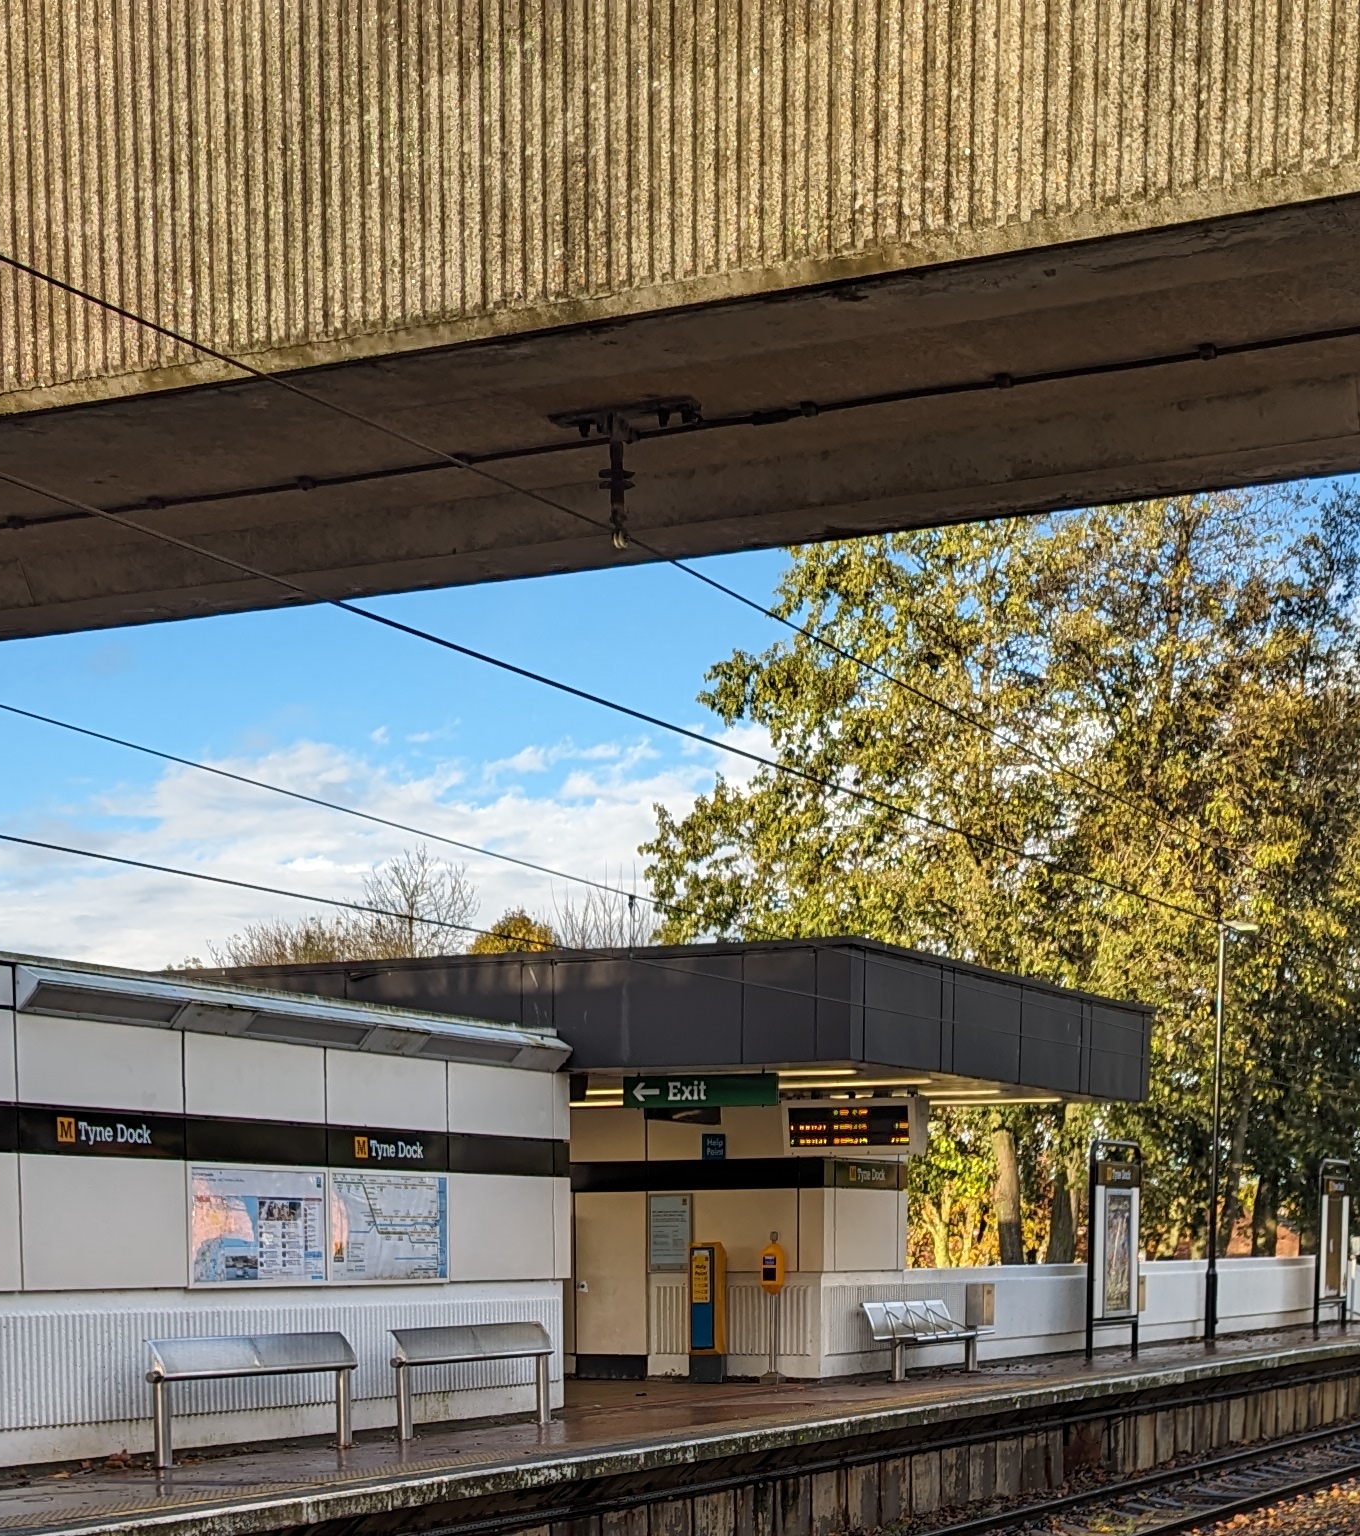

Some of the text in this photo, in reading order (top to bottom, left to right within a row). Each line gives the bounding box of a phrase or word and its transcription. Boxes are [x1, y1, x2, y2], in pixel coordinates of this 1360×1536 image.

[667, 1081, 707, 1101] Exit
[59, 1119, 152, 1144] M Tyne Dock
[356, 1139, 424, 1160] M Tyne Dock
[706, 1138, 724, 1147] Help
[857, 1167, 870, 1182] Tyne
[872, 1168, 885, 1181] Dock
